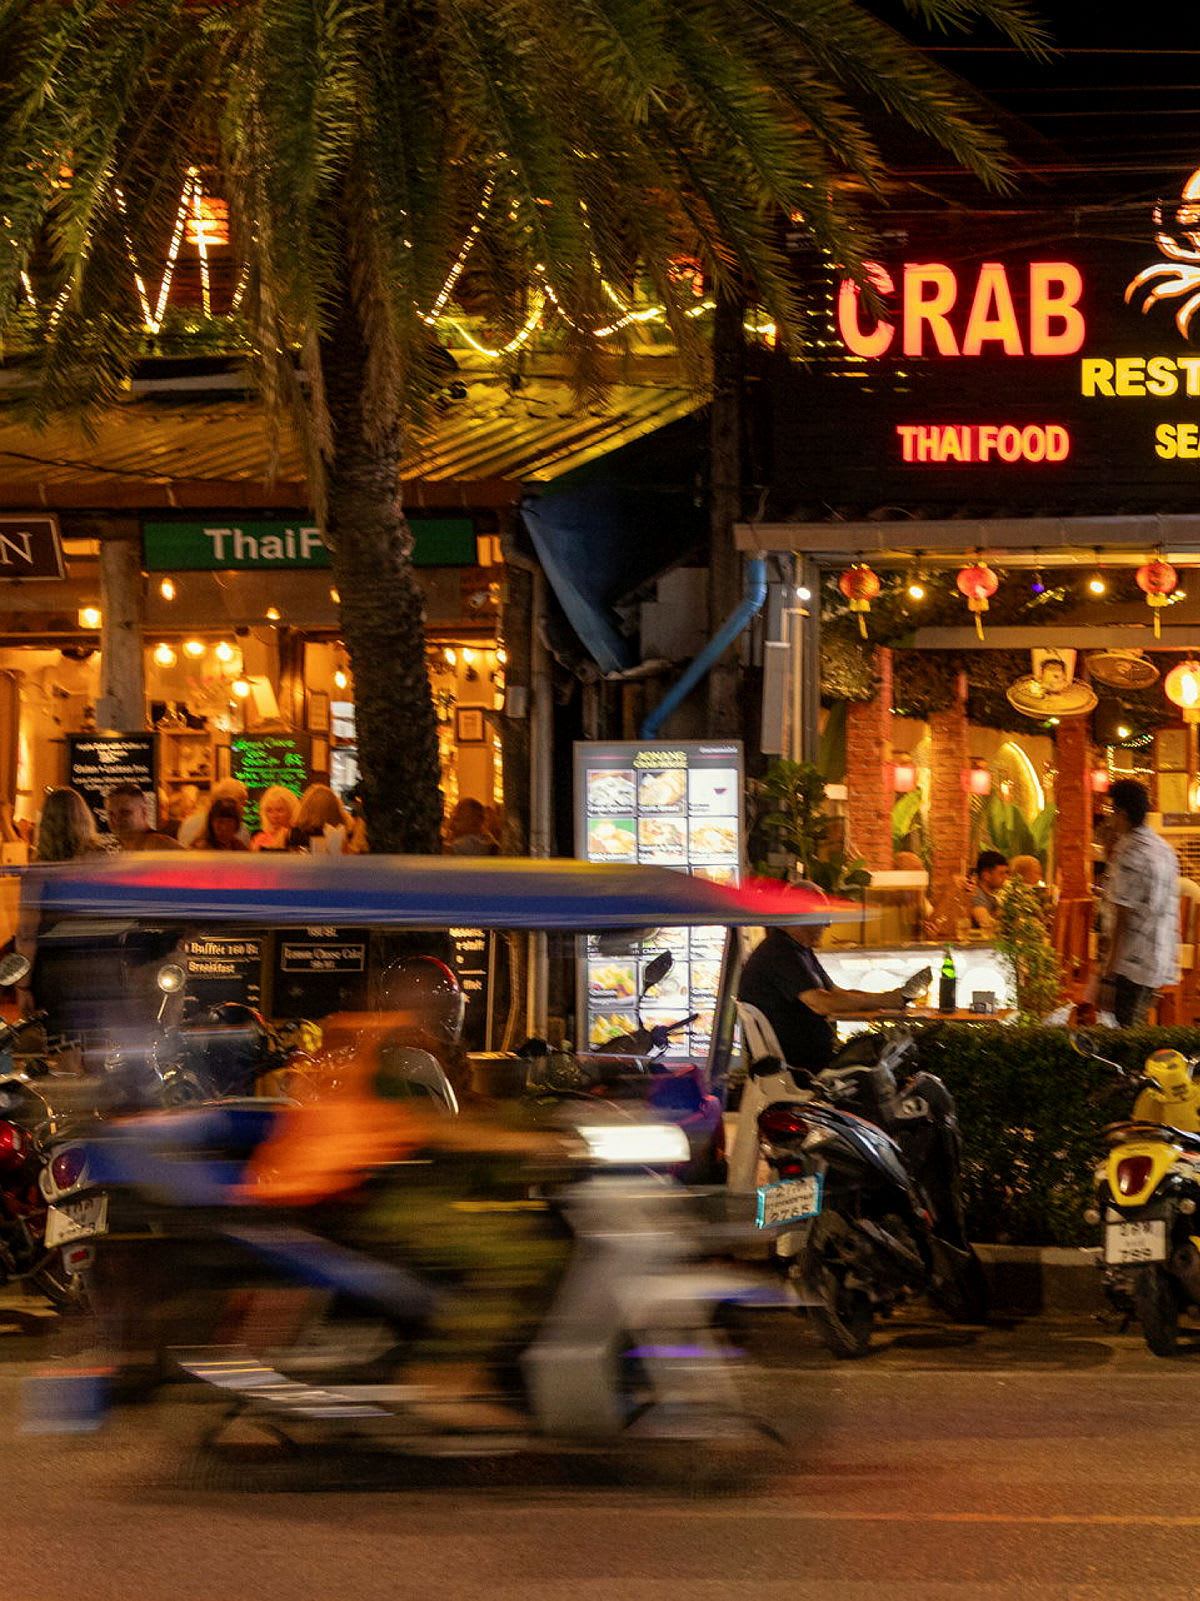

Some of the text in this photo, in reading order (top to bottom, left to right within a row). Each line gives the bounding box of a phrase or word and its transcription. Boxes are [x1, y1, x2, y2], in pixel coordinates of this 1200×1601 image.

[838, 261, 1086, 358] CRAB
[896, 424, 1070, 462] THAI FOOD
[203, 527, 324, 560] ThaiF
